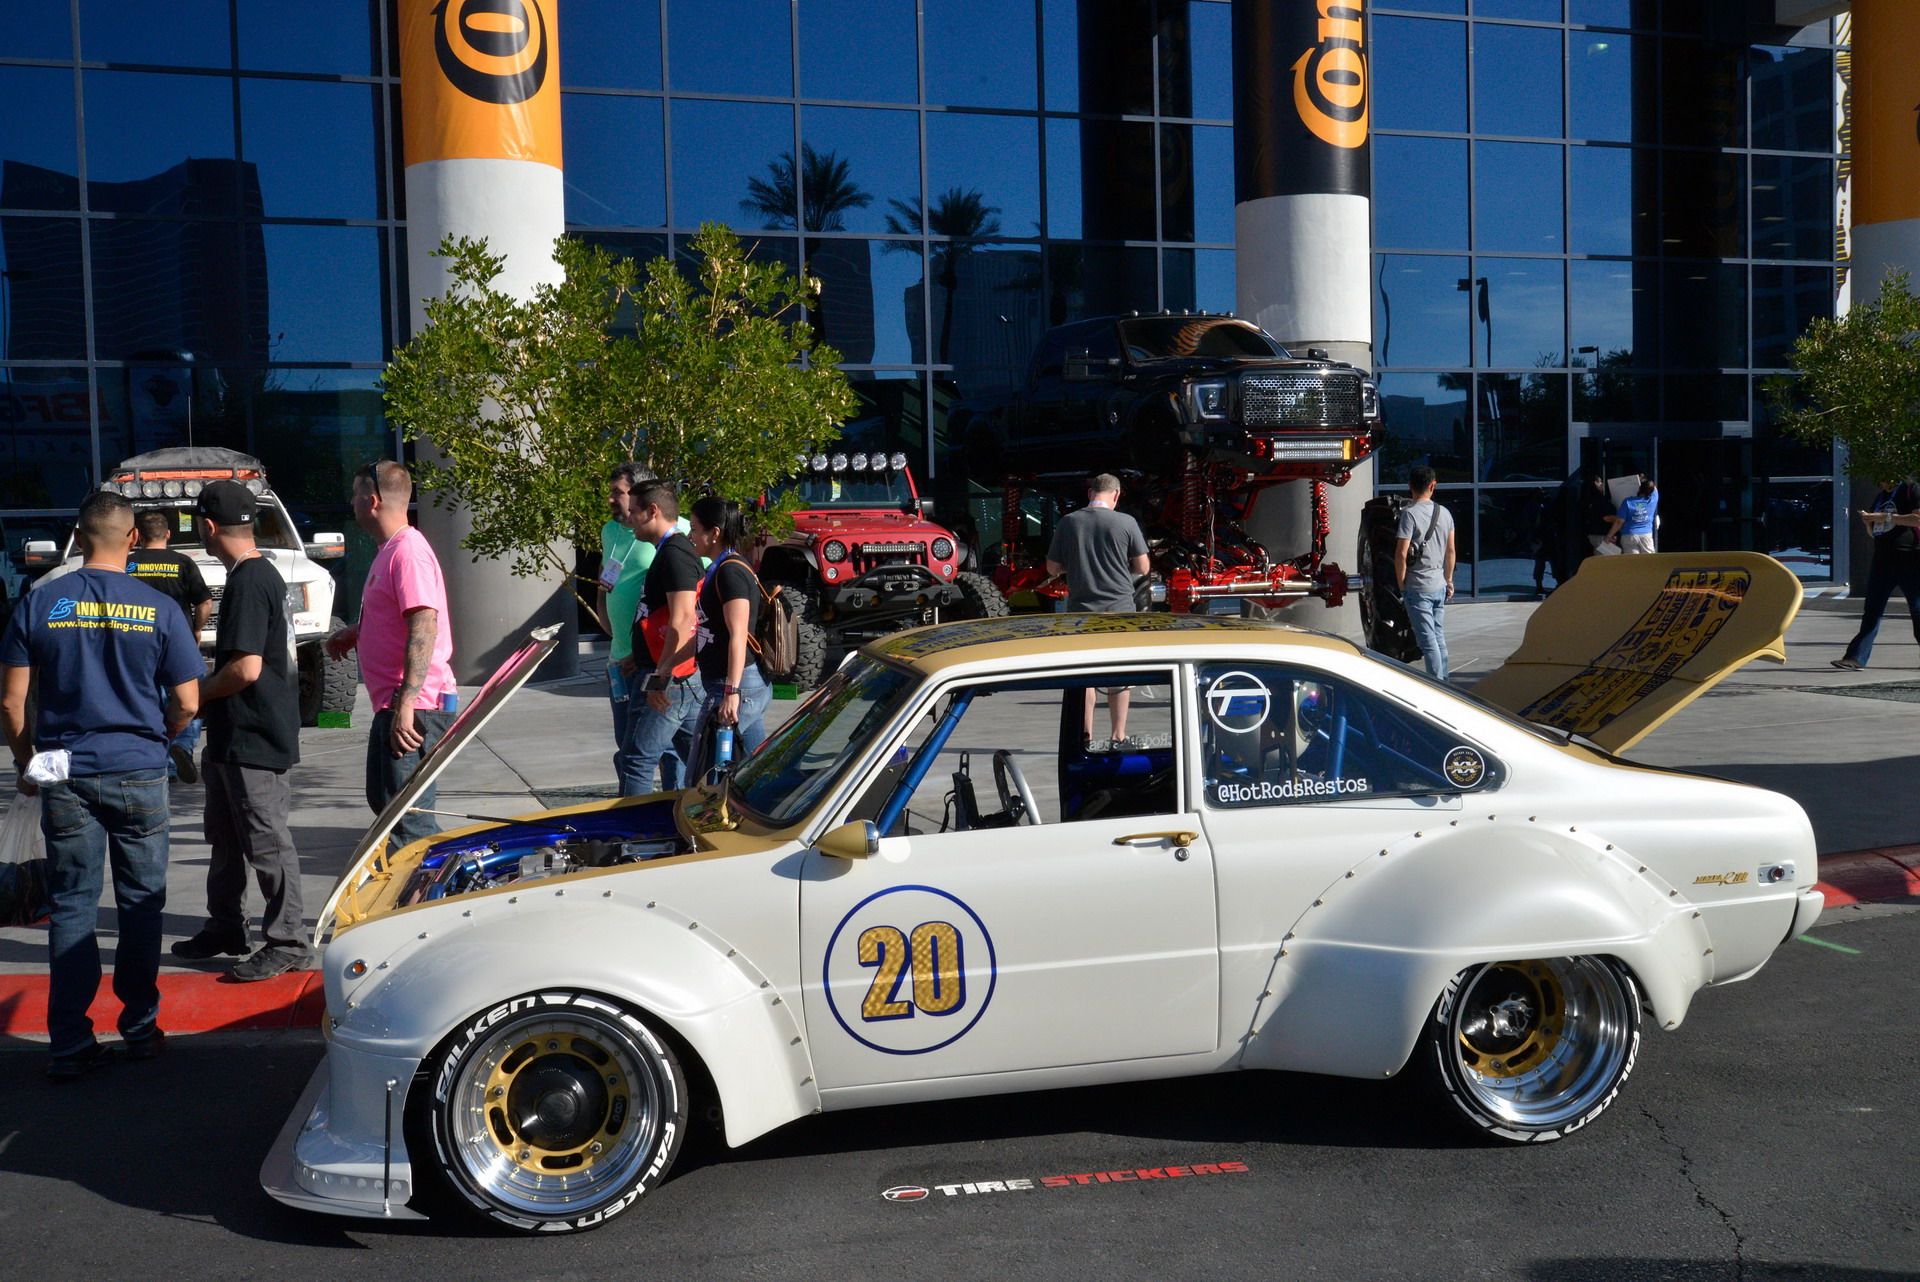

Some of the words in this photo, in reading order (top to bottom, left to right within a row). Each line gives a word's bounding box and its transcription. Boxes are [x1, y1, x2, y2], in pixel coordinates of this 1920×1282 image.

[138, 563, 179, 572] INNOVATIVE
[77, 601, 156, 621] INNOVATIVE
[1218, 777, 1368, 802] @HotRodsRestos
[858, 921, 966, 1023] 20
[436, 996, 536, 1103] FALKEN
[577, 1121, 676, 1228] FALKEN
[934, 1179, 1035, 1197] TIRE
[1039, 1162, 1250, 1187] STICKERS
